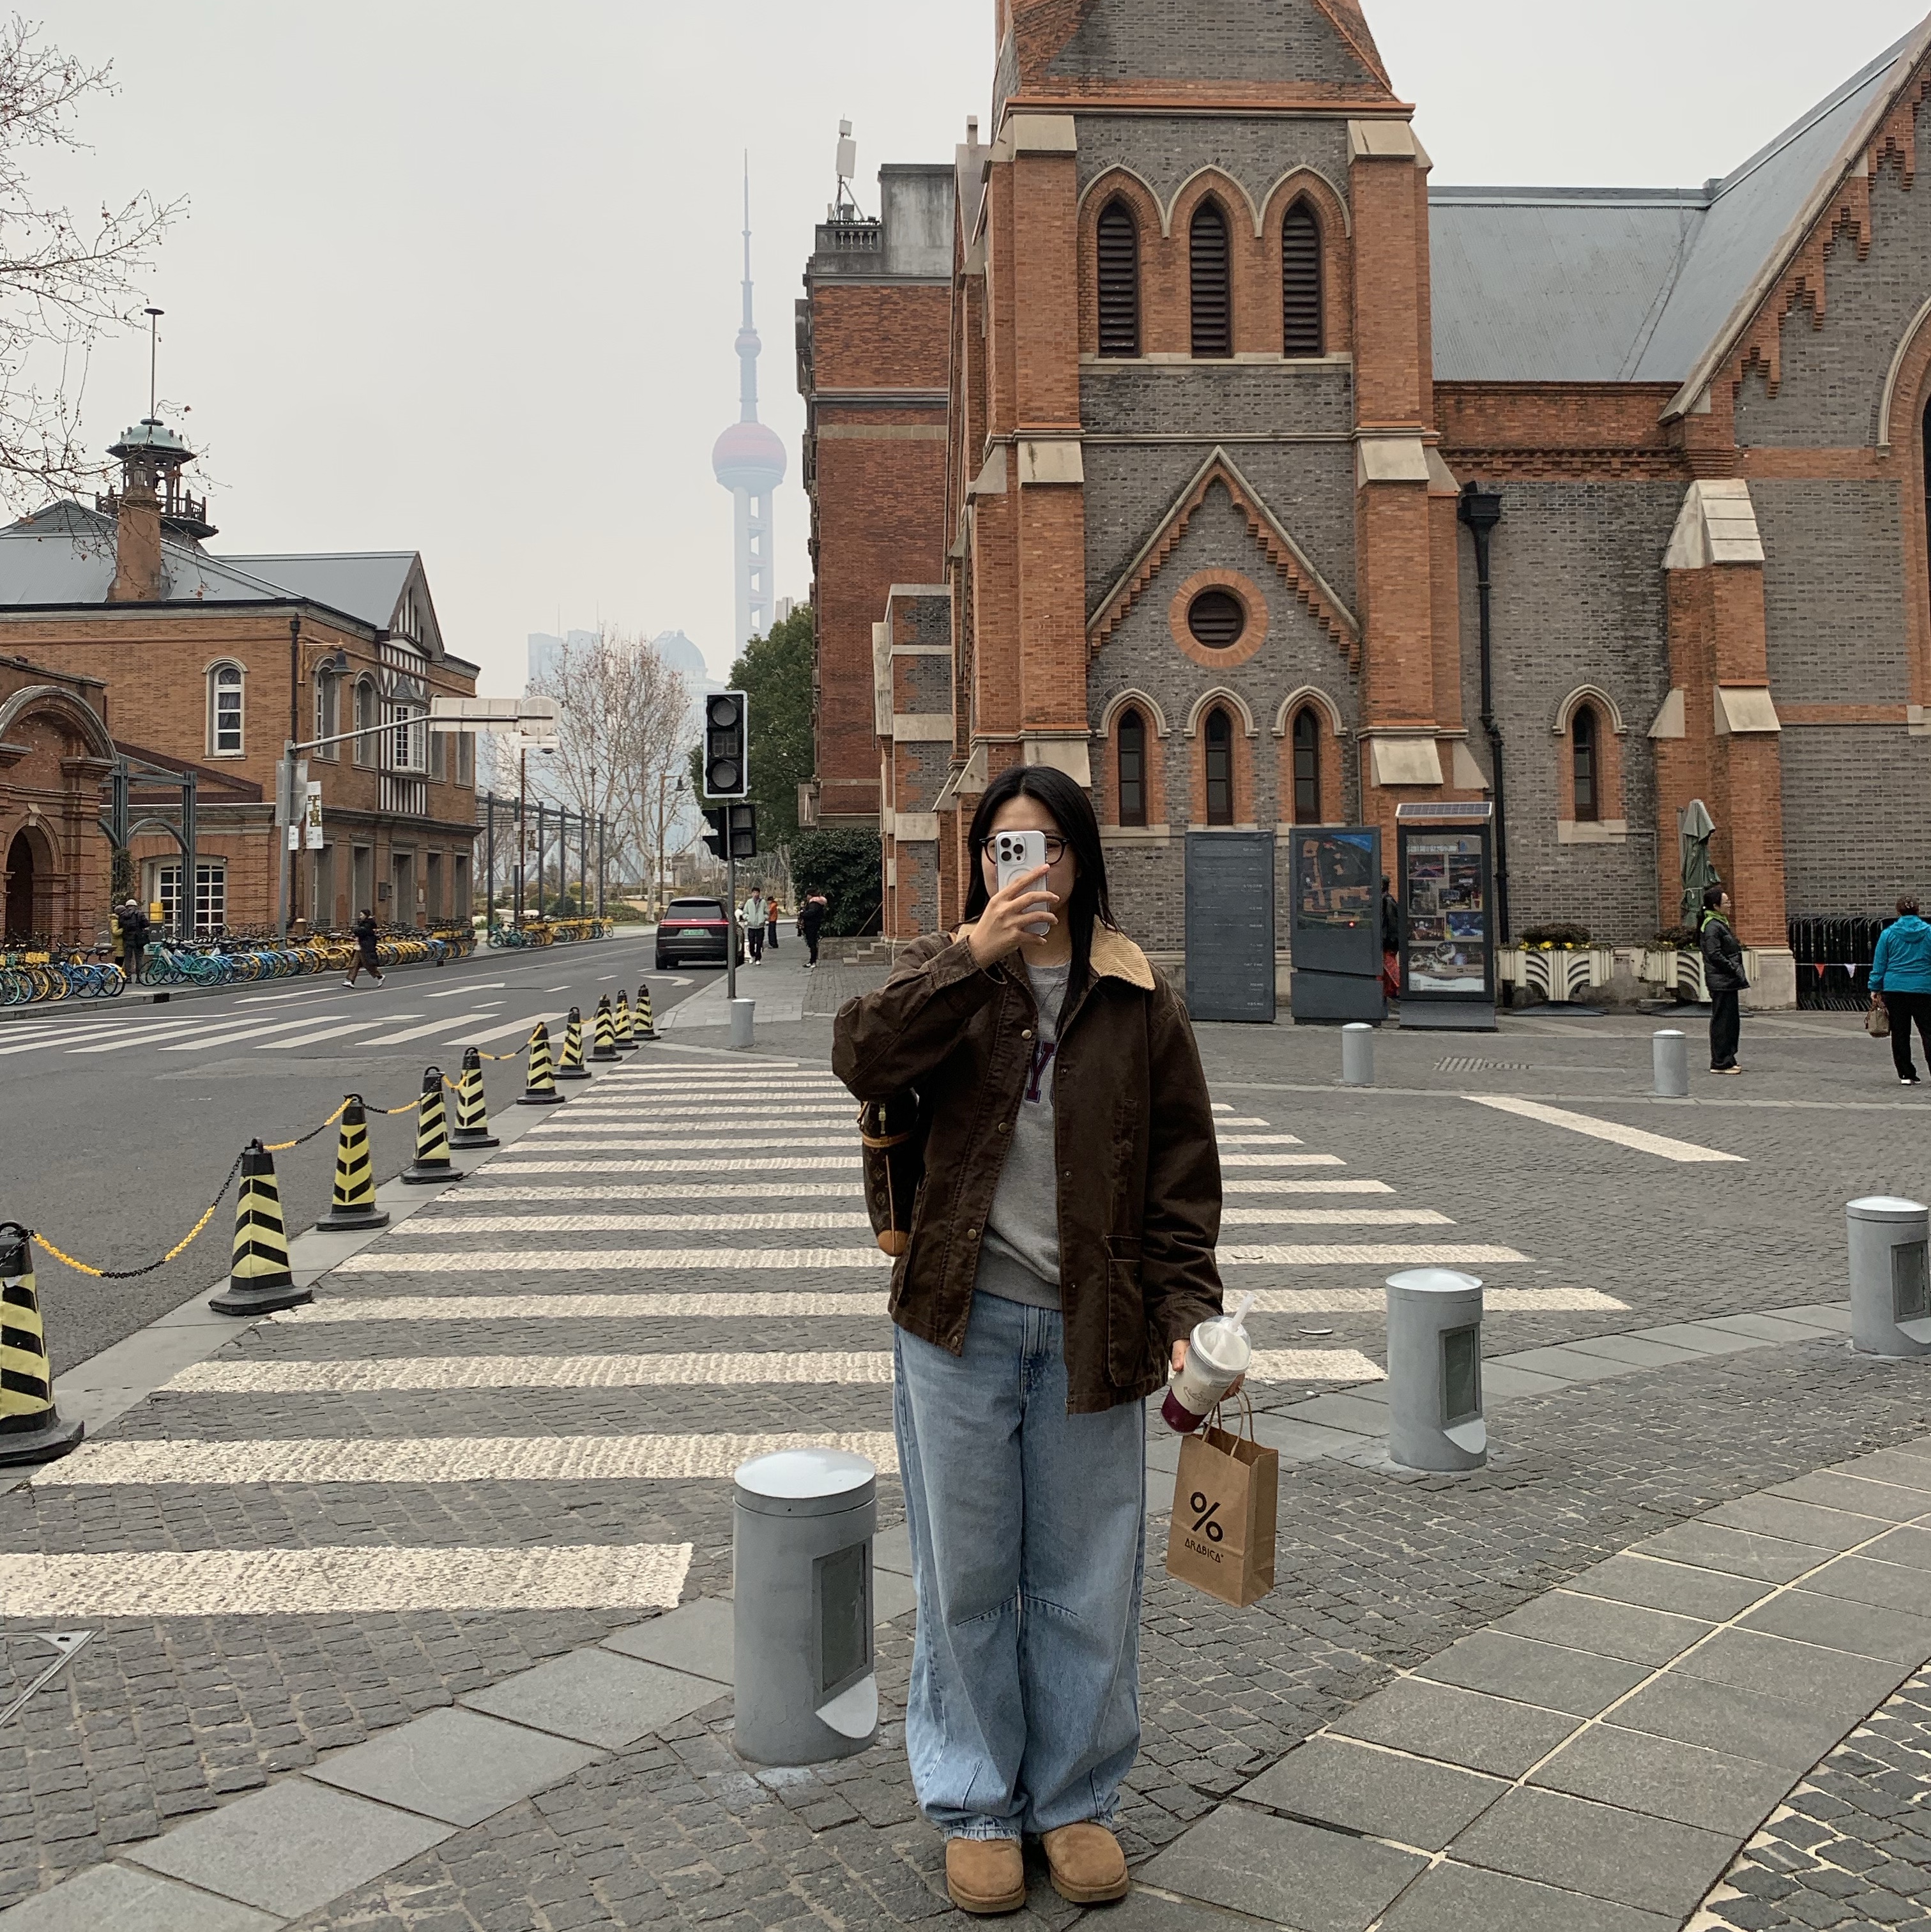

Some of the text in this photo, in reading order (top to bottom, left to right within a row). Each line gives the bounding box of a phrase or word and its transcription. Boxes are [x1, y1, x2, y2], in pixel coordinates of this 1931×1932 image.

[1025, 1040, 1055, 1105] Y
[1190, 1491, 1223, 1542] %
[1184, 1538, 1221, 1563] ARABICA
